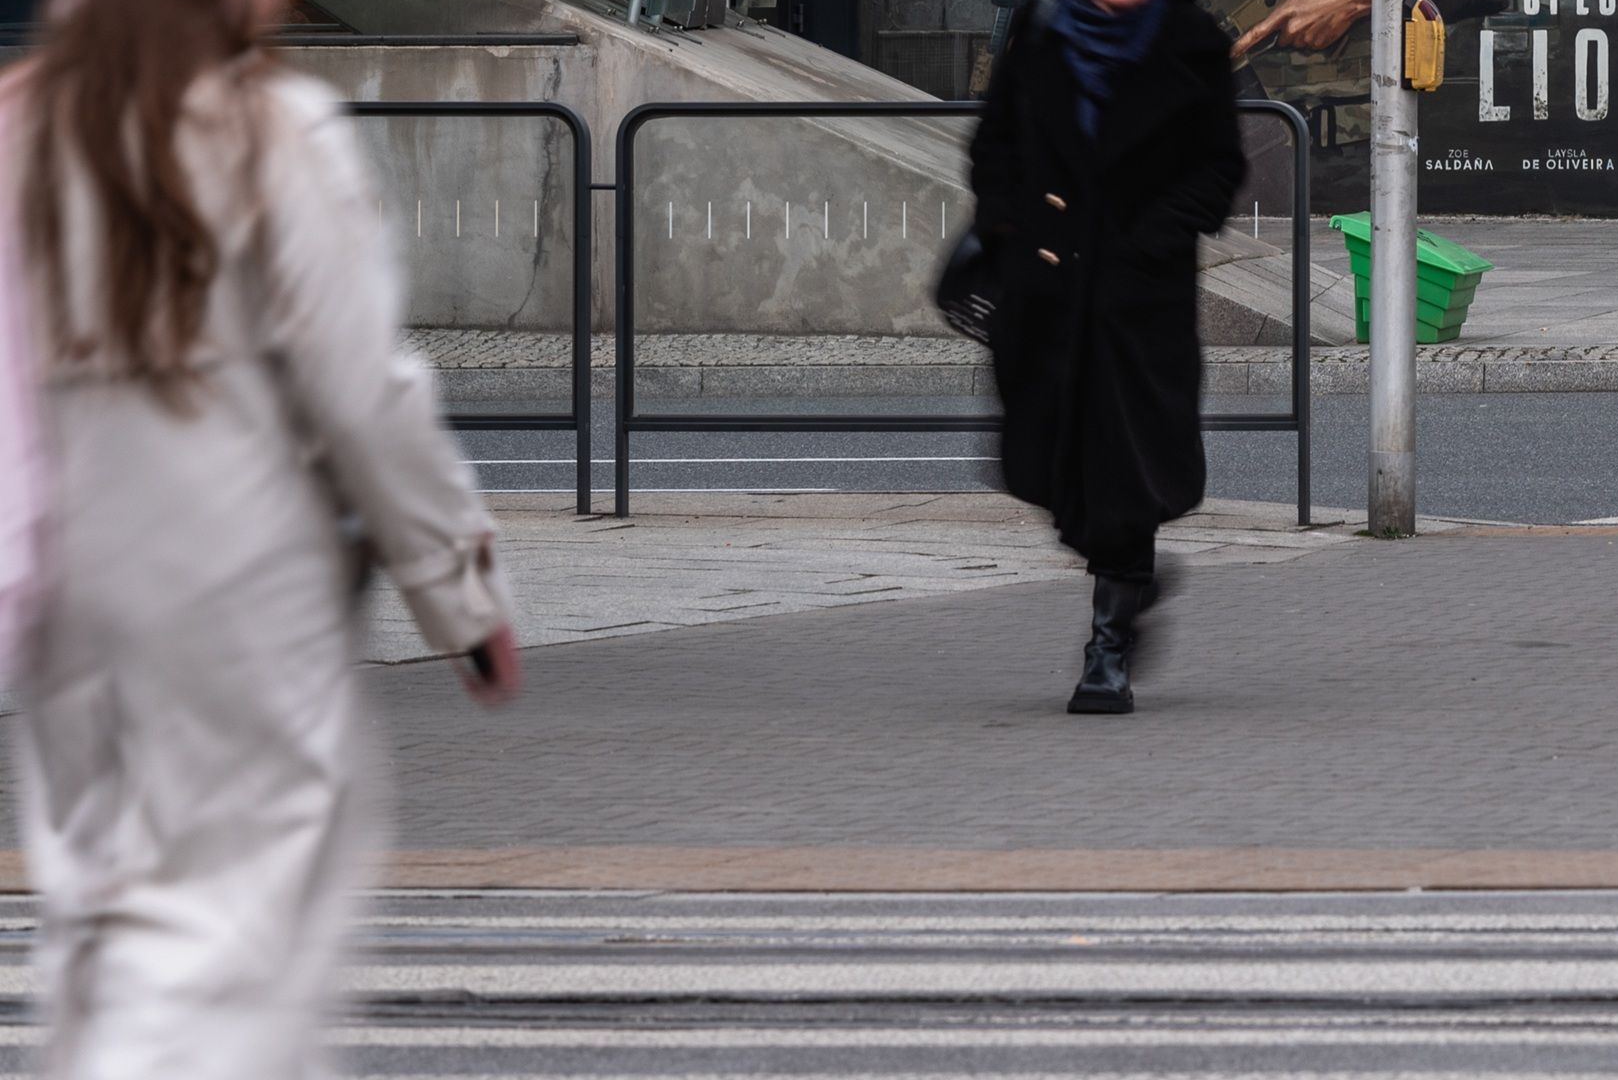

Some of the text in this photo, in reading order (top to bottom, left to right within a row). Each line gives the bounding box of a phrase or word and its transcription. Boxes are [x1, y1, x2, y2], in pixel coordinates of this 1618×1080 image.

[1448, 149, 1469, 158] ZOE
[1547, 149, 1587, 158] LAYSLA
[1425, 157, 1495, 170] SALDAÑA
[1522, 159, 1616, 170] DE OLIVEIRA
